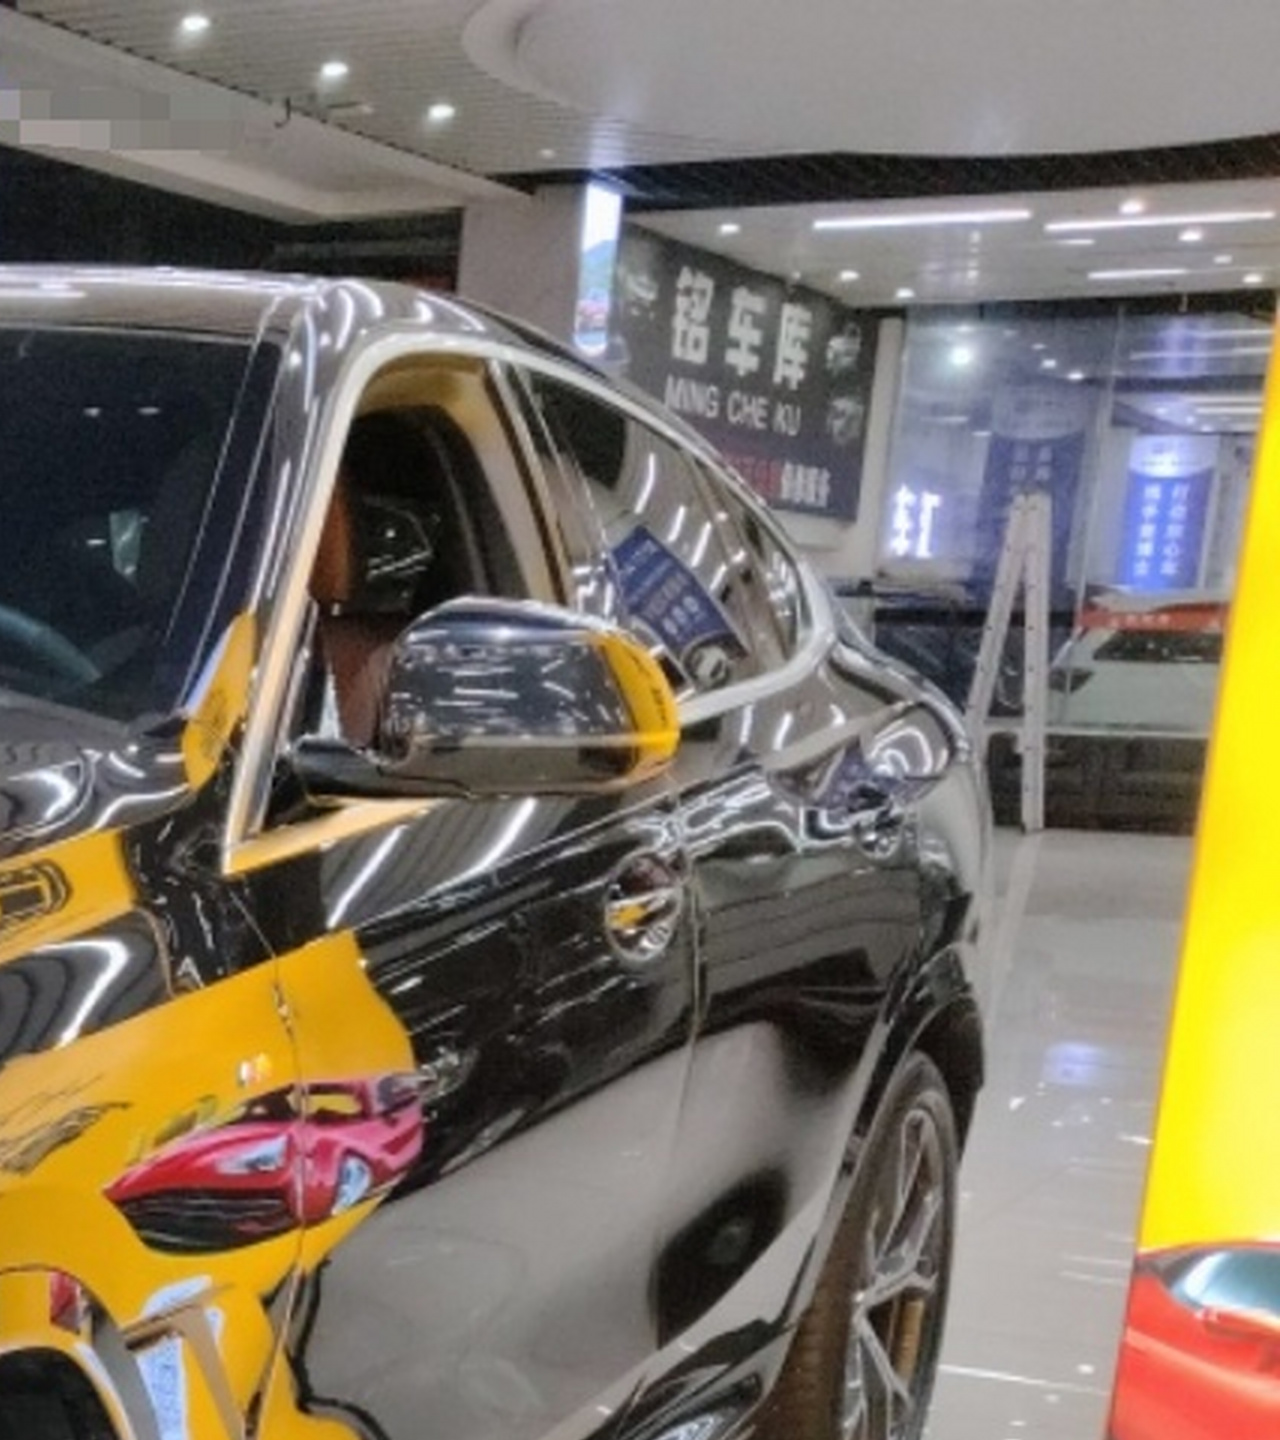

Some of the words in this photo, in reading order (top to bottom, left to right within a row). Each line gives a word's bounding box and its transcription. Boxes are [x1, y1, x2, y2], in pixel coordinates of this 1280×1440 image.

[672, 266, 813, 391] 铭车库
[664, 375, 719, 420] MING
[727, 391, 770, 430] CHE
[774, 403, 802, 437] KU
